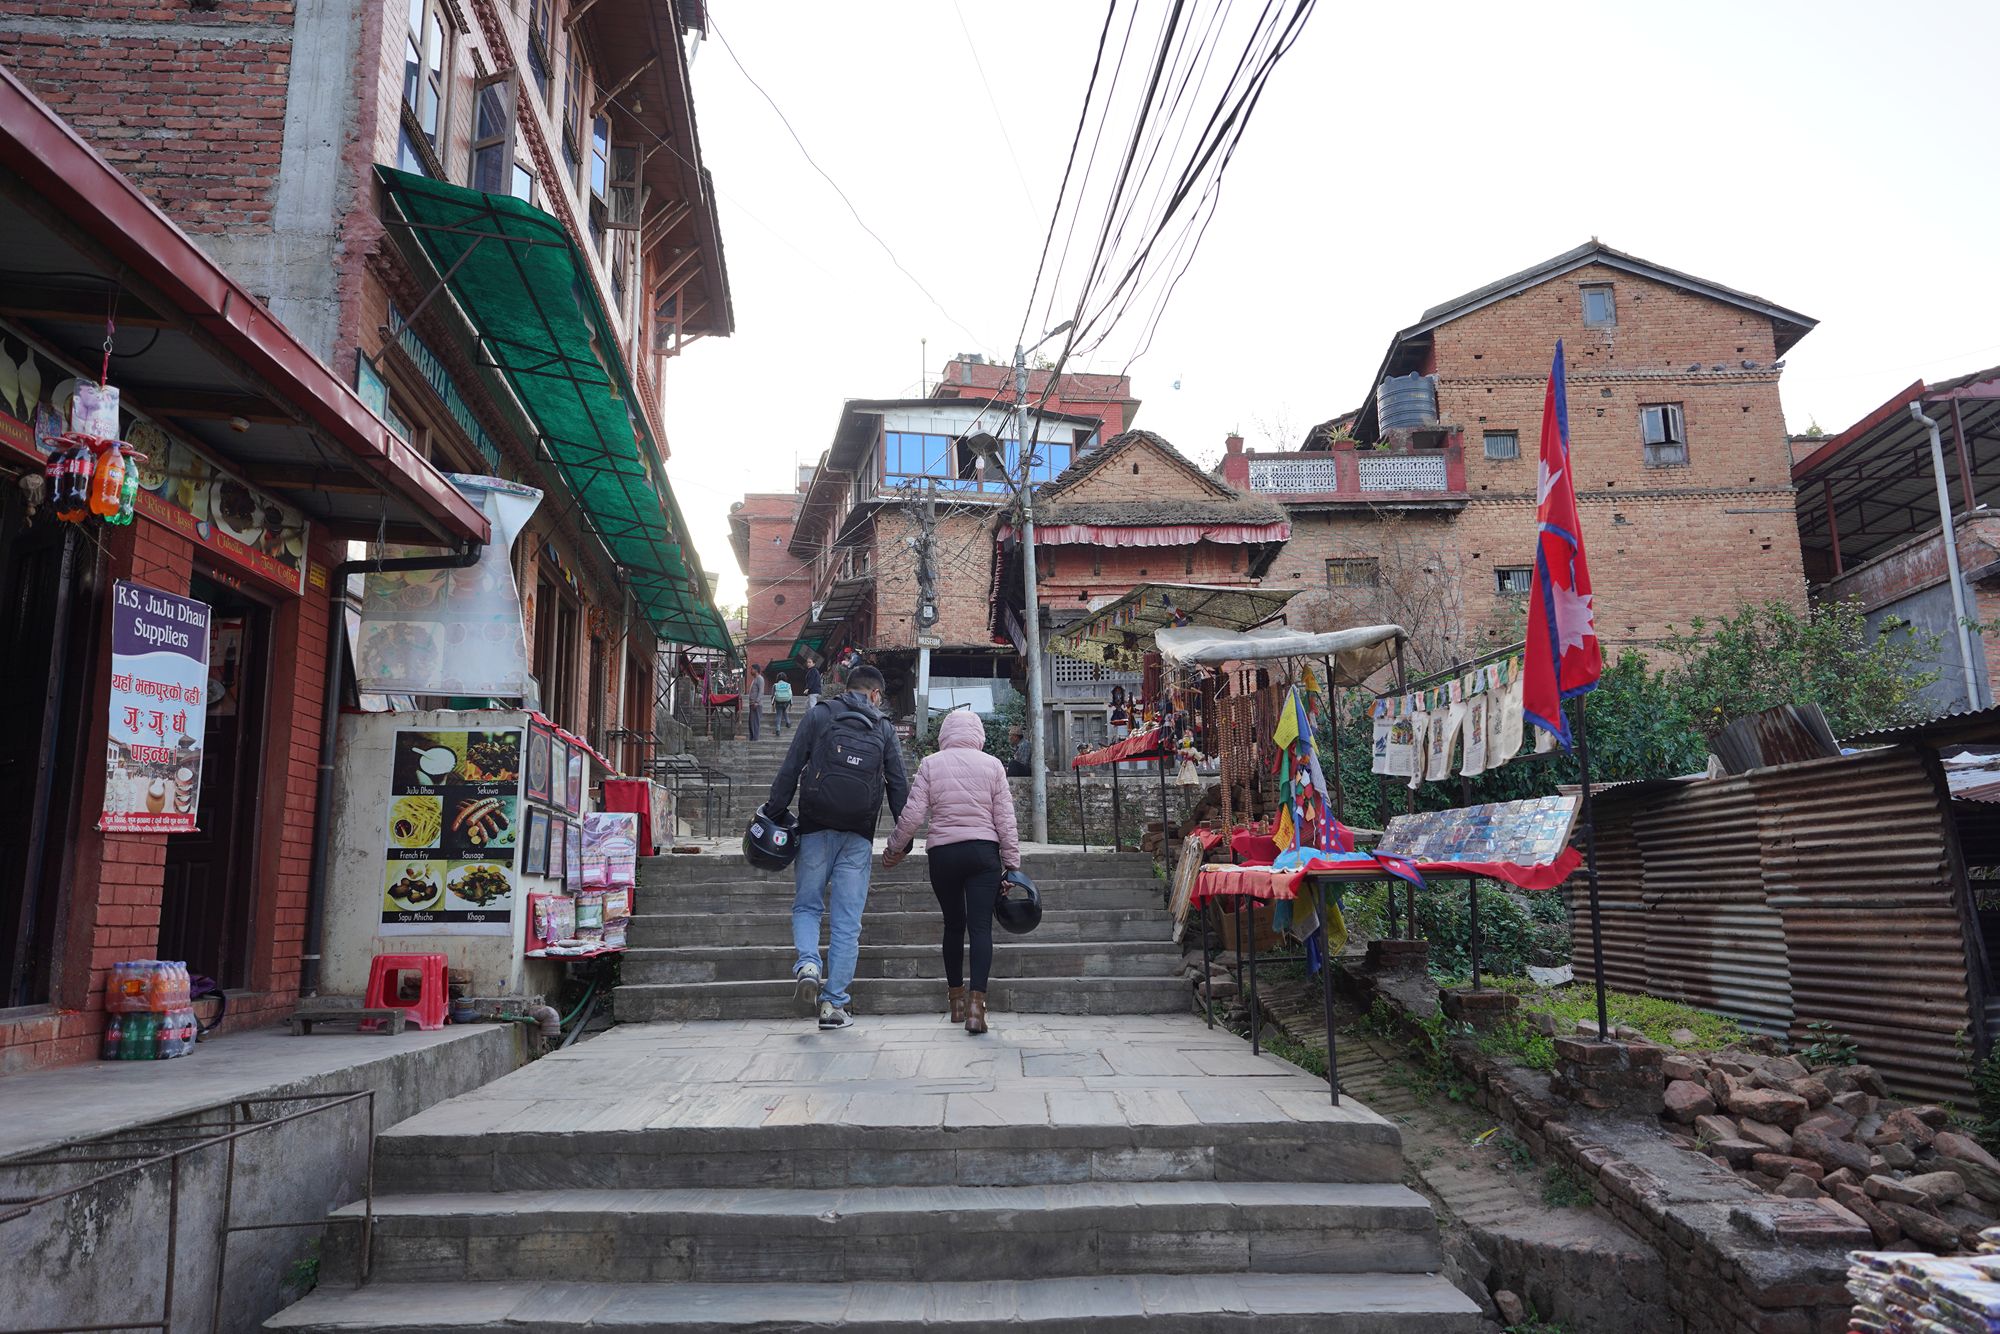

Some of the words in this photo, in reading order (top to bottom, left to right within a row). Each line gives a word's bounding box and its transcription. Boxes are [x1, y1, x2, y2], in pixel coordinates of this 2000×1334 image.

[447, 381, 480, 446] SOUVENIR
[480, 434, 500, 472] SHOP
[117, 586, 142, 610] R.S.
[145, 595, 175, 619] JuJu
[177, 603, 206, 628] Dhau
[134, 617, 189, 648] Suppliers
[918, 636, 941, 646] MUSEUM
[183, 686, 201, 704] दही
[846, 755, 863, 766] CAT
[420, 785, 435, 795] Dhau
[477, 785, 499, 795] Sekuwa
[400, 850, 418, 859] French
[419, 851, 429, 860] Fry
[462, 850, 485, 861] Sausage
[398, 912, 412, 922] Sapu
